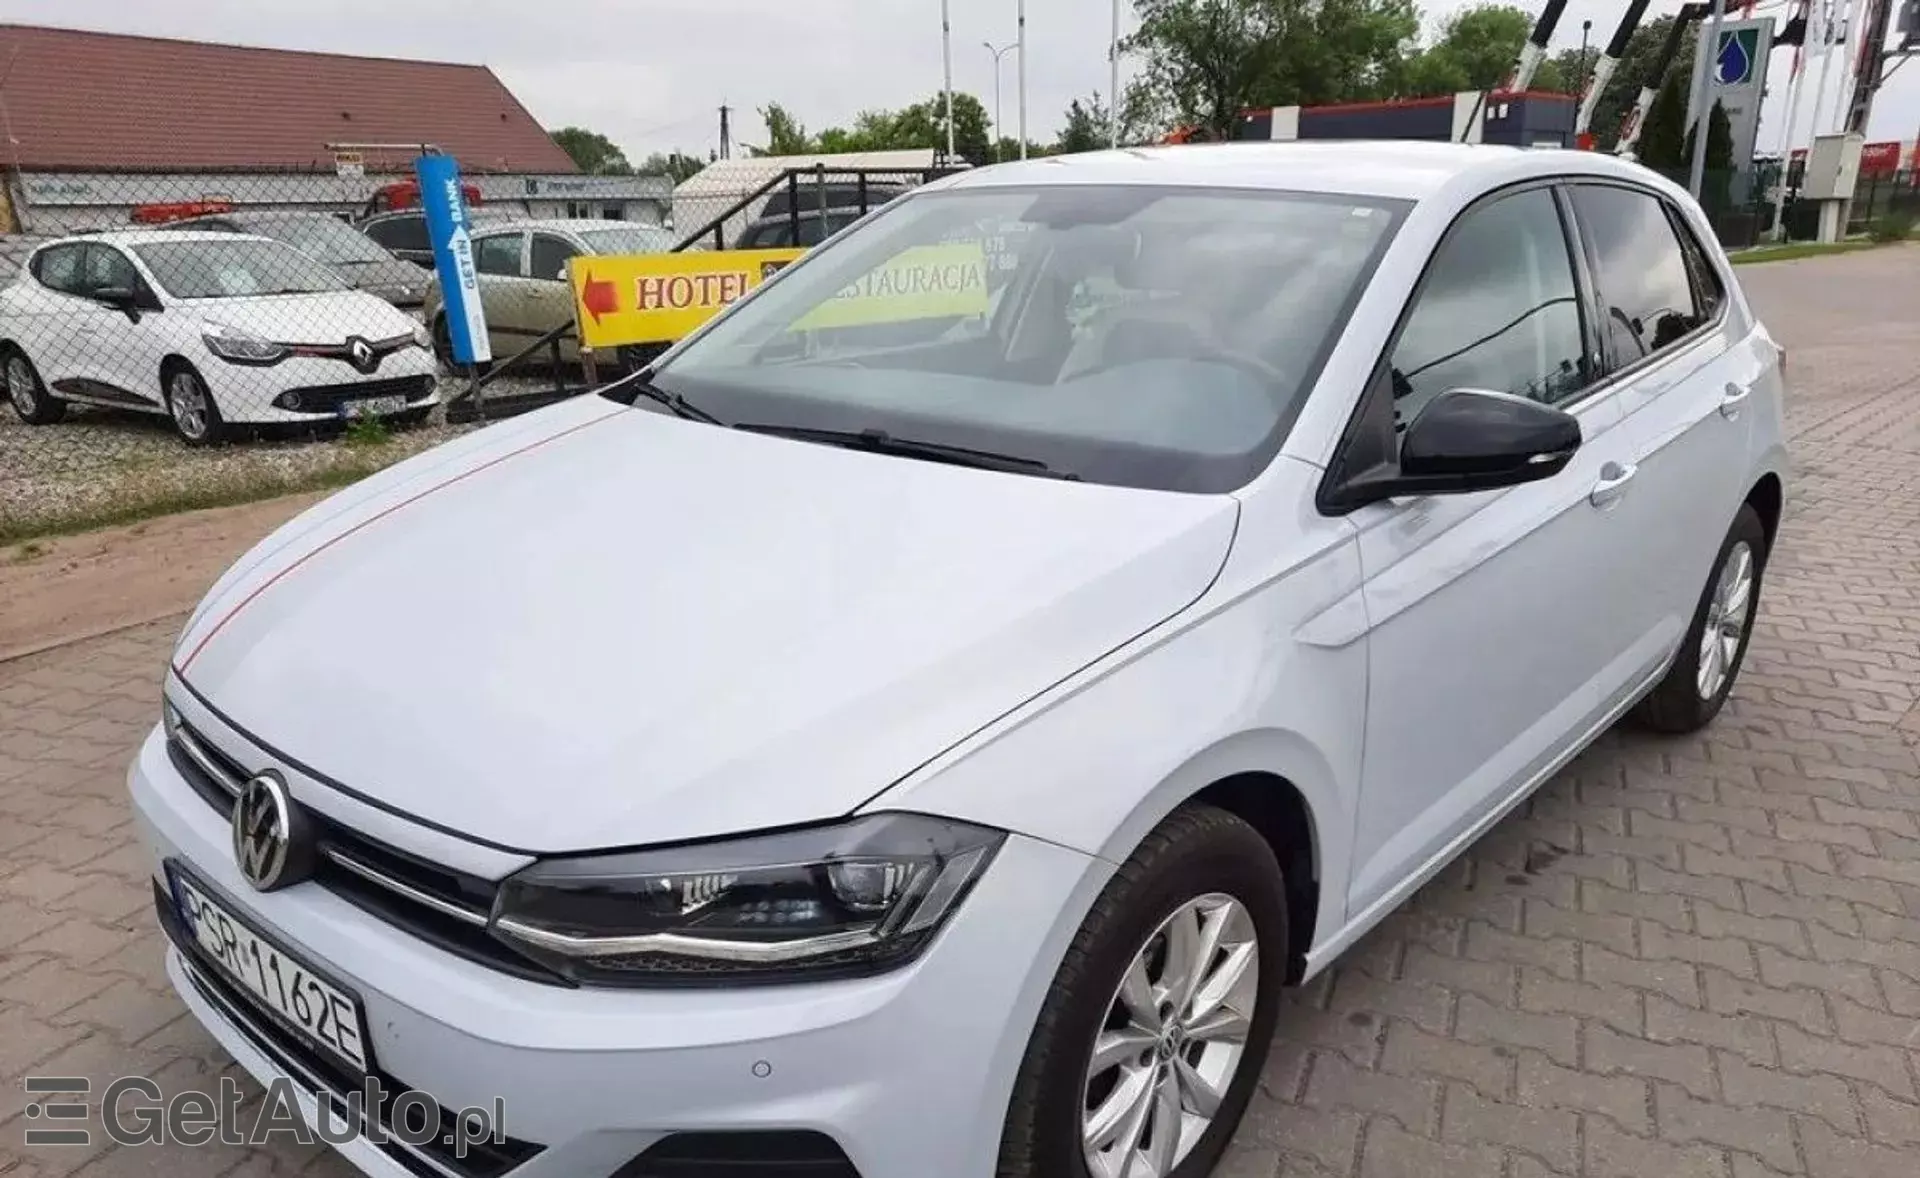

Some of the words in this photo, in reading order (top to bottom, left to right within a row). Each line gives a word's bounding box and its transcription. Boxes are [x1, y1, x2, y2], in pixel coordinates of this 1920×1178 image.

[444, 178, 462, 222] BANK
[637, 274, 748, 310] HOTEL
[184, 886, 244, 977] PSR
[250, 938, 363, 1065] 1162E
